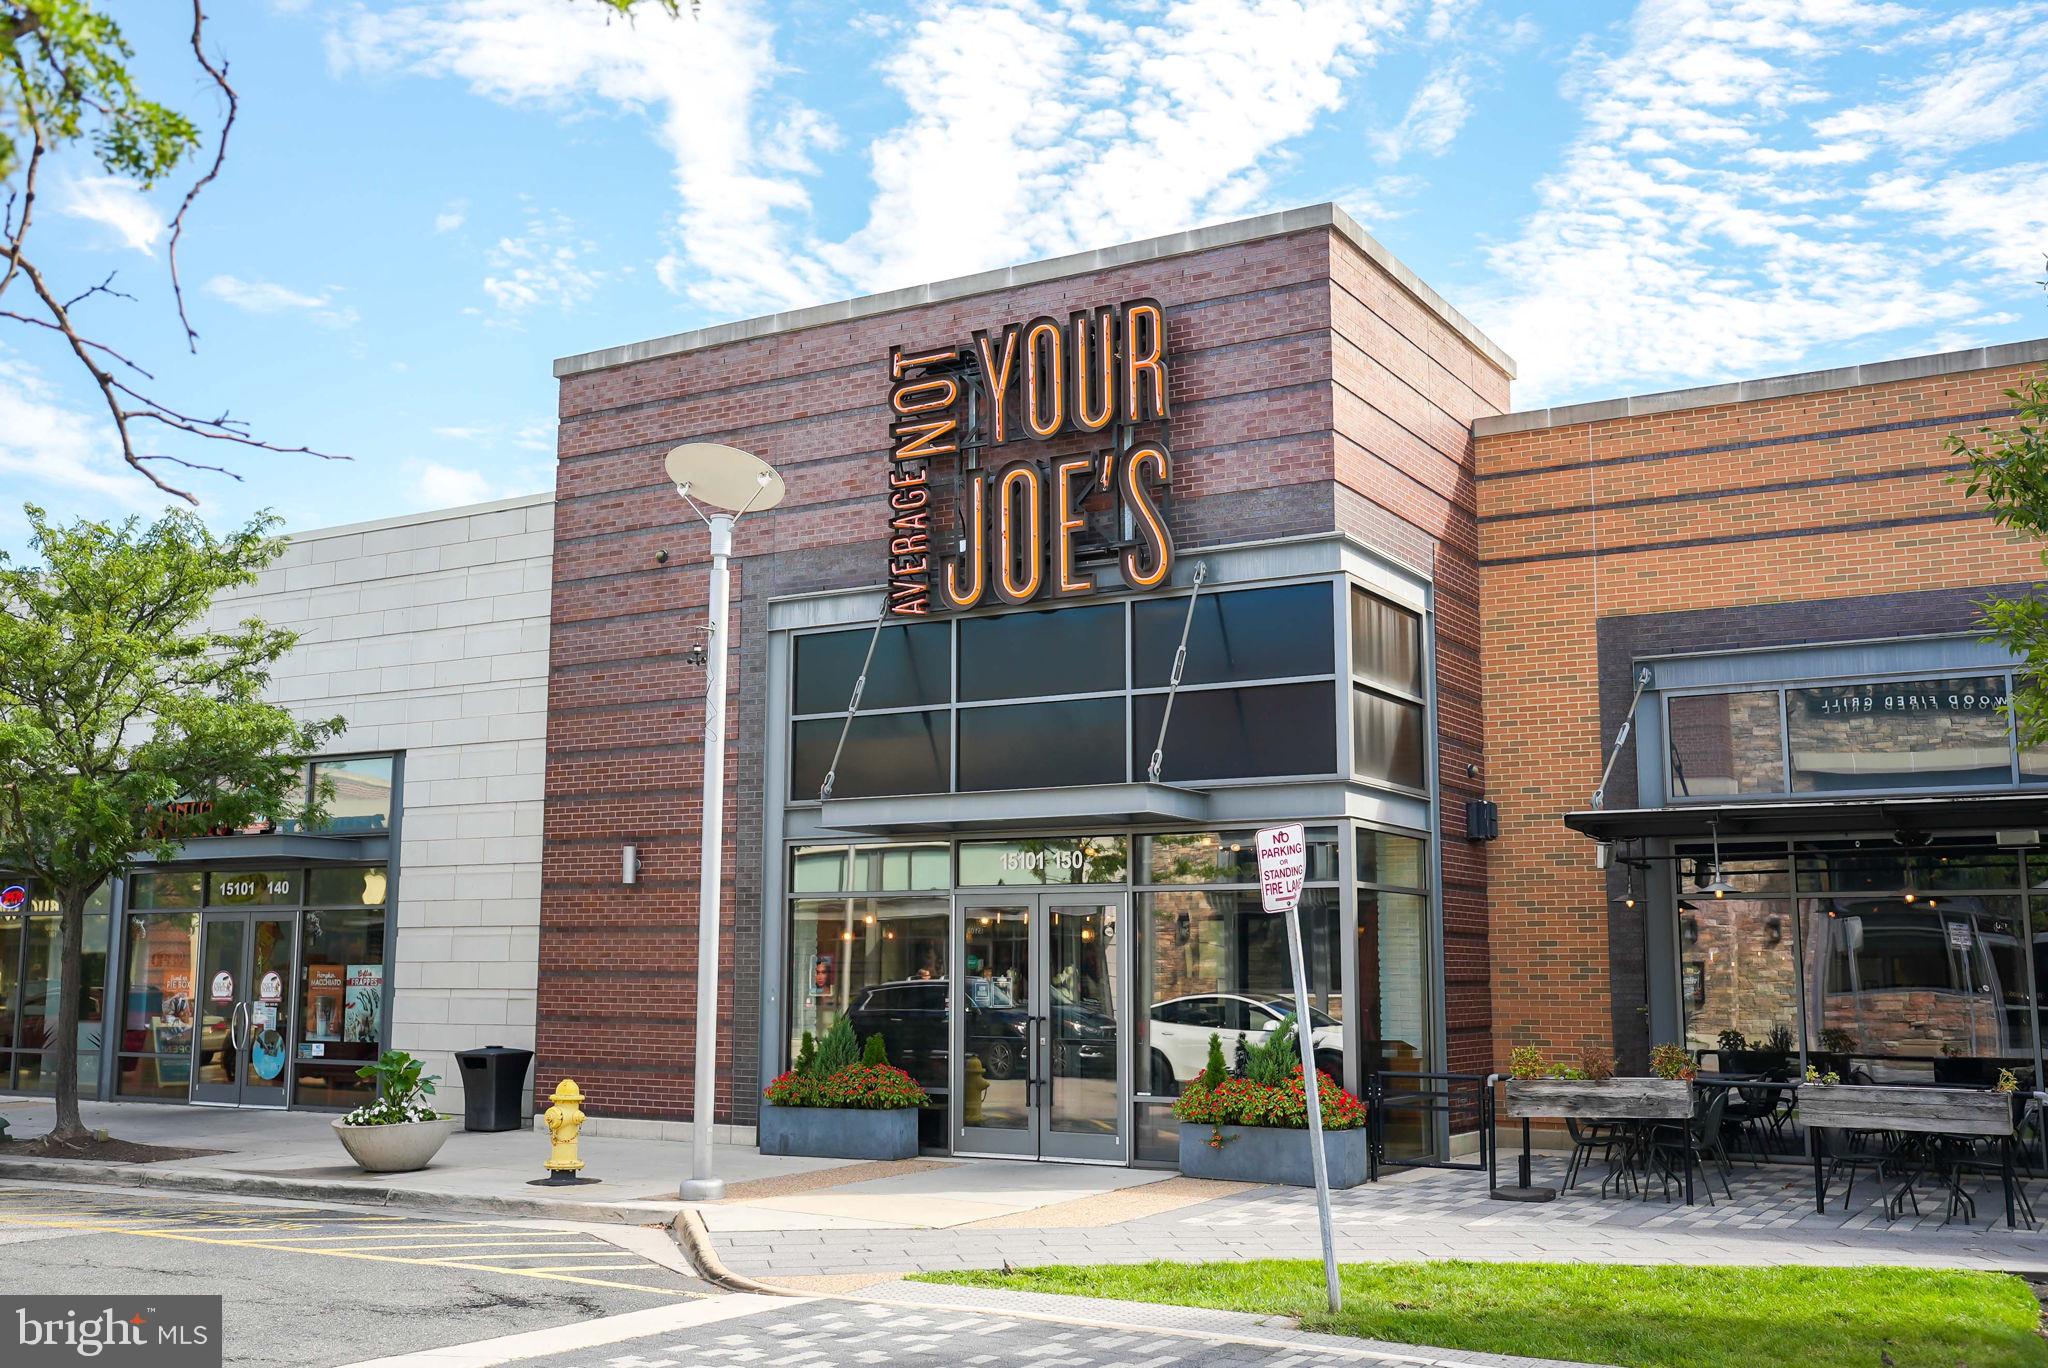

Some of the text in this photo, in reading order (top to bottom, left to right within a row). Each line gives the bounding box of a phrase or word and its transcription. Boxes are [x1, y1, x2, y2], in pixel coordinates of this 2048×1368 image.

[972, 298, 1171, 446] YOUR
[889, 345, 959, 462] NOT
[939, 440, 1174, 611] JOE'S
[888, 464, 930, 616] AVERAGE
[1272, 832, 1290, 845] NO
[1261, 843, 1302, 860] PARKING
[1000, 850, 1083, 871] 15101 150
[1263, 864, 1303, 881] STANDING
[219, 880, 290, 896] 15101 140
[1265, 881, 1284, 896] FIRE
[310, 979, 342, 987] MACCHIATO
